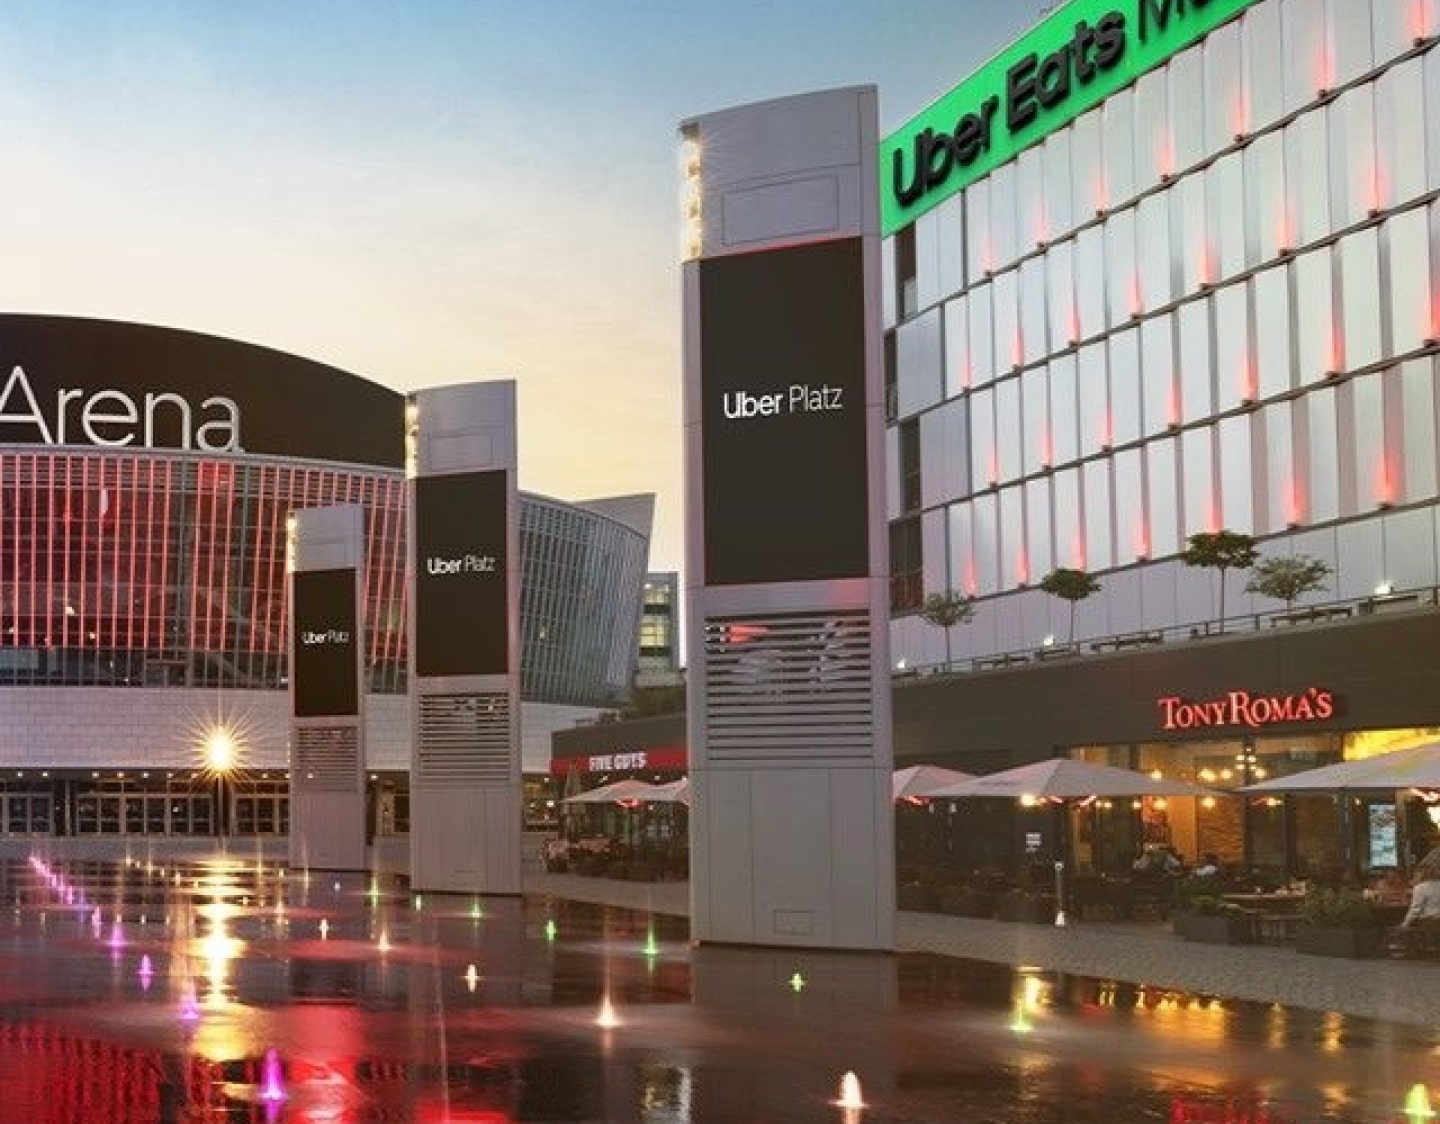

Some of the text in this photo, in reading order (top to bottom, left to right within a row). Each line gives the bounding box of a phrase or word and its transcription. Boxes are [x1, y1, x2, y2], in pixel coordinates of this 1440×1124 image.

[892, 94, 999, 207] Uber
[1006, 10, 1126, 134] Eats
[723, 383, 844, 419] Uber Platz
[427, 554, 496, 575] Uber Platz
[301, 630, 327, 644] Uber
